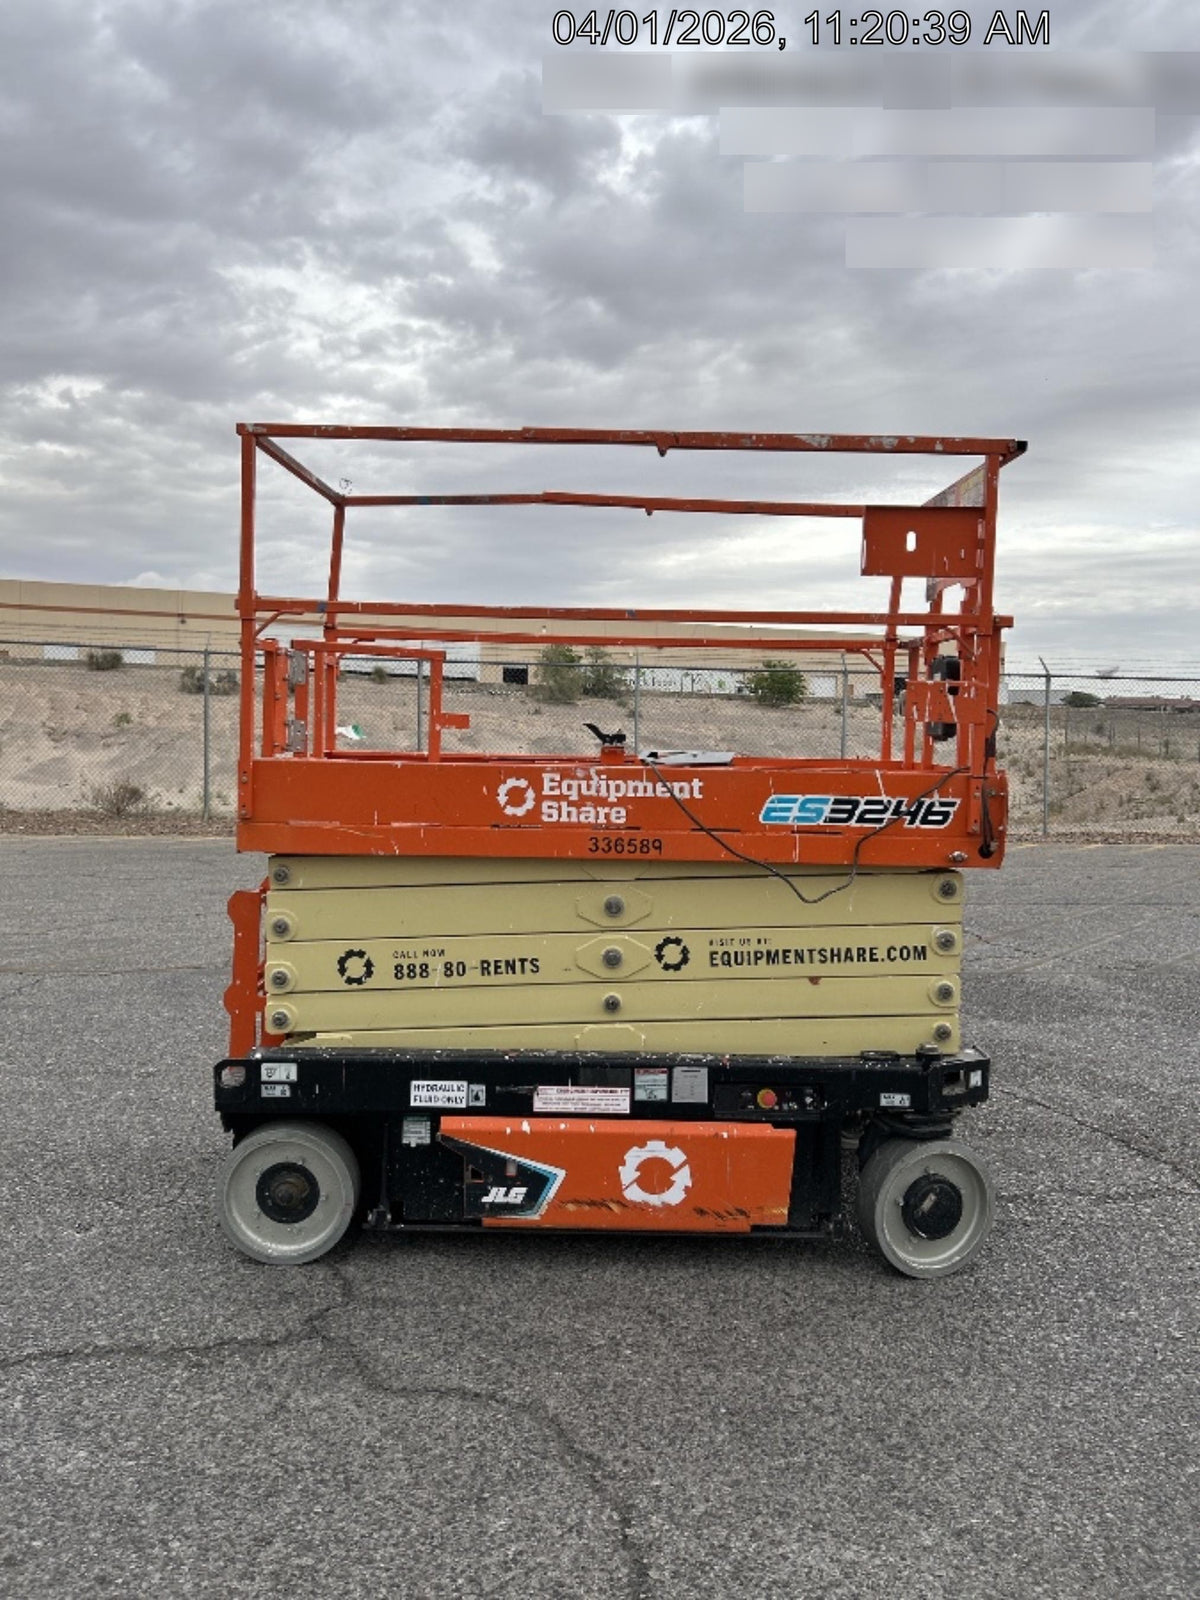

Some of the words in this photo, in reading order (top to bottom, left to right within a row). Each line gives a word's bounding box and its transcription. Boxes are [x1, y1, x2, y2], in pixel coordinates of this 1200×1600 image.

[541, 773, 704, 802] Equipment
[541, 801, 627, 824] Share
[759, 794, 961, 829] ES3246
[588, 837, 663, 855] 336589
[392, 950, 419, 959] CALL
[422, 949, 446, 958] NOW
[709, 945, 928, 967] EQUIPMENTSHARE.COM
[413, 1084, 465, 1093] HYDRAULIC
[413, 1095, 440, 1103] FLUID
[441, 1096, 465, 1105] ONLY
[481, 1186, 529, 1205] JLG
